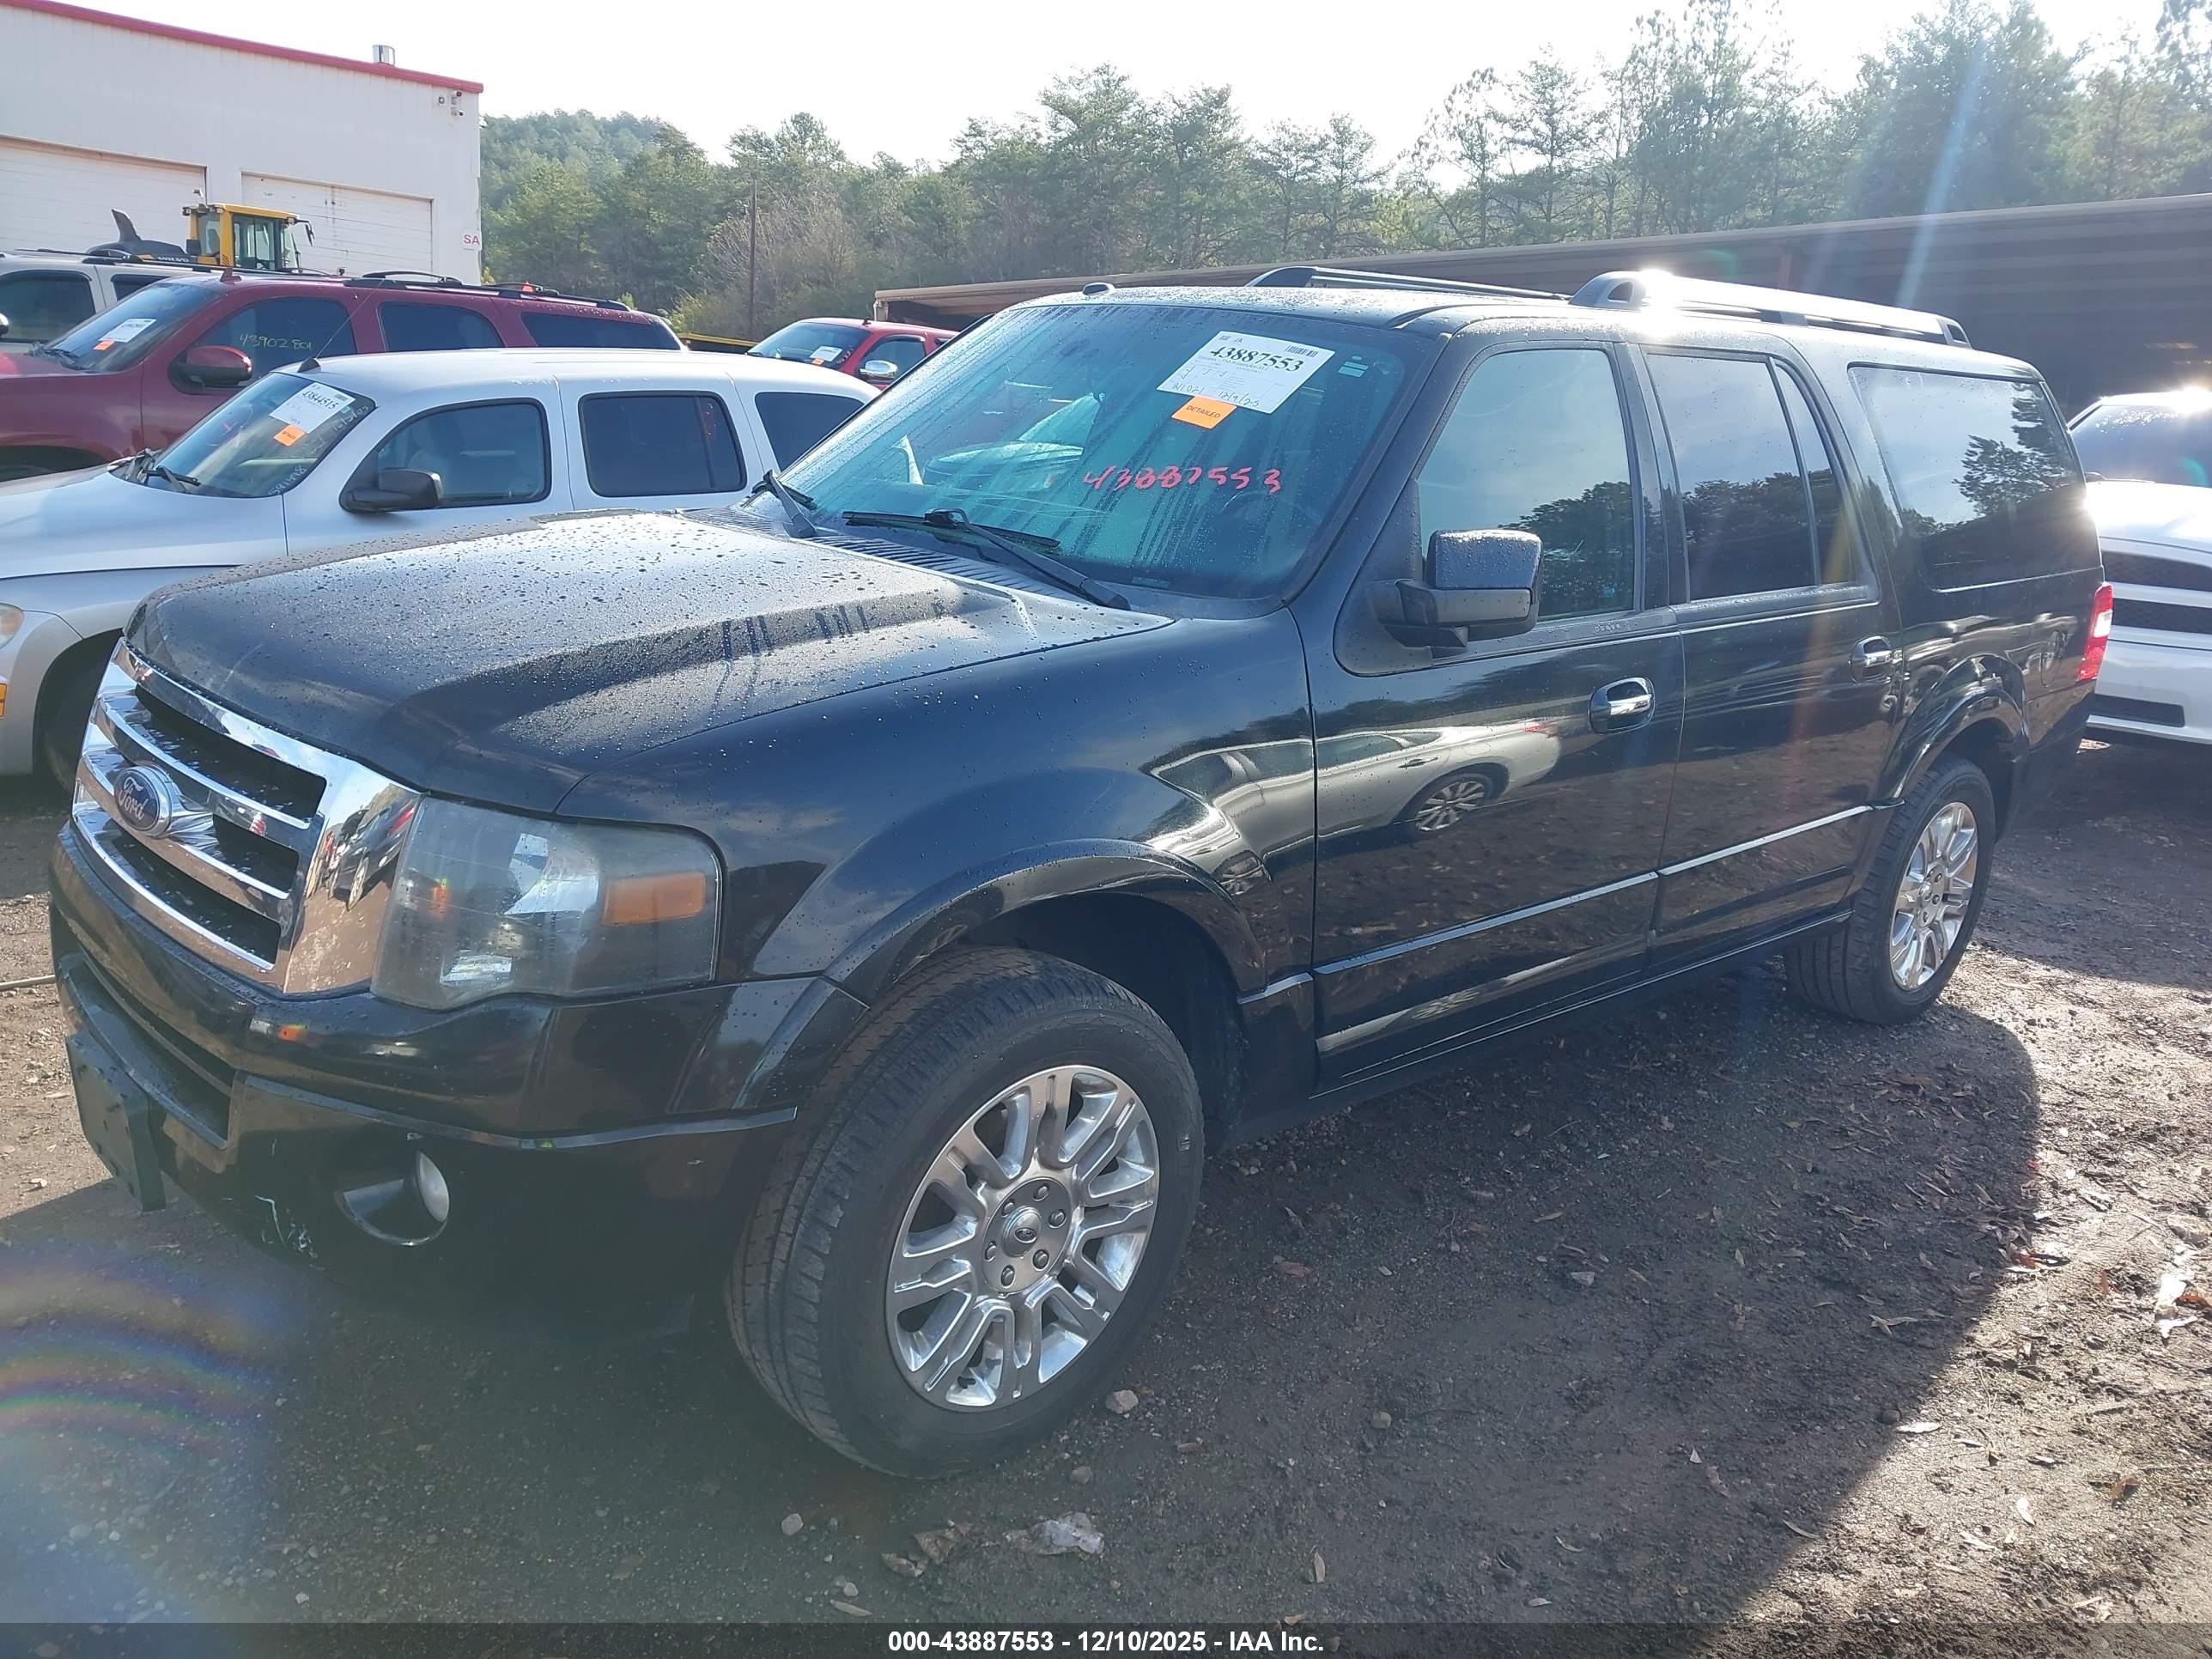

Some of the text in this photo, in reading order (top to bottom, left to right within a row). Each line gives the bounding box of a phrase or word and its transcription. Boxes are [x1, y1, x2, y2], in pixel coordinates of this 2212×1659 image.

[240, 334, 312, 350] 43902801
[1210, 346, 1304, 372] 43887553
[1186, 404, 1221, 418] DETAILED
[1083, 465, 1281, 495] 43887553
[118, 776, 149, 820] Ford
